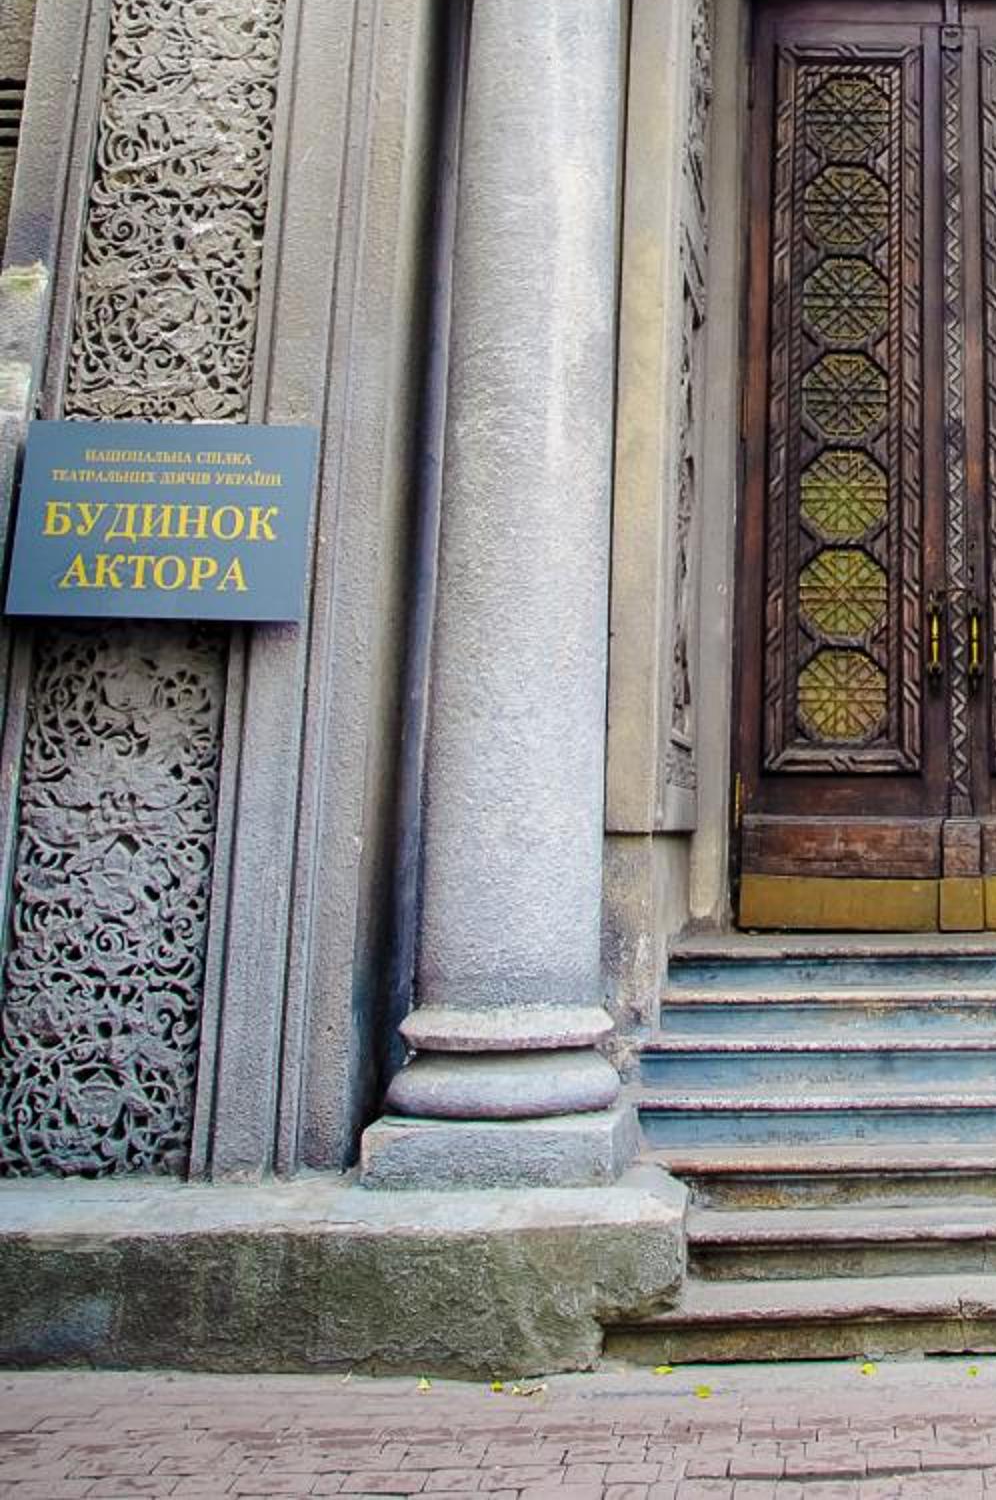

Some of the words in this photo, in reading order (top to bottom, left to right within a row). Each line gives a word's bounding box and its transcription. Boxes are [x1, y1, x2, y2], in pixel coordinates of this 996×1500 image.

[52, 469, 156, 484] ТЕАТРАЛЬНИХ
[215, 470, 283, 487] УКРАЇНИ
[42, 501, 279, 544] БУДИНОК
[58, 553, 249, 592] АКТОРА
